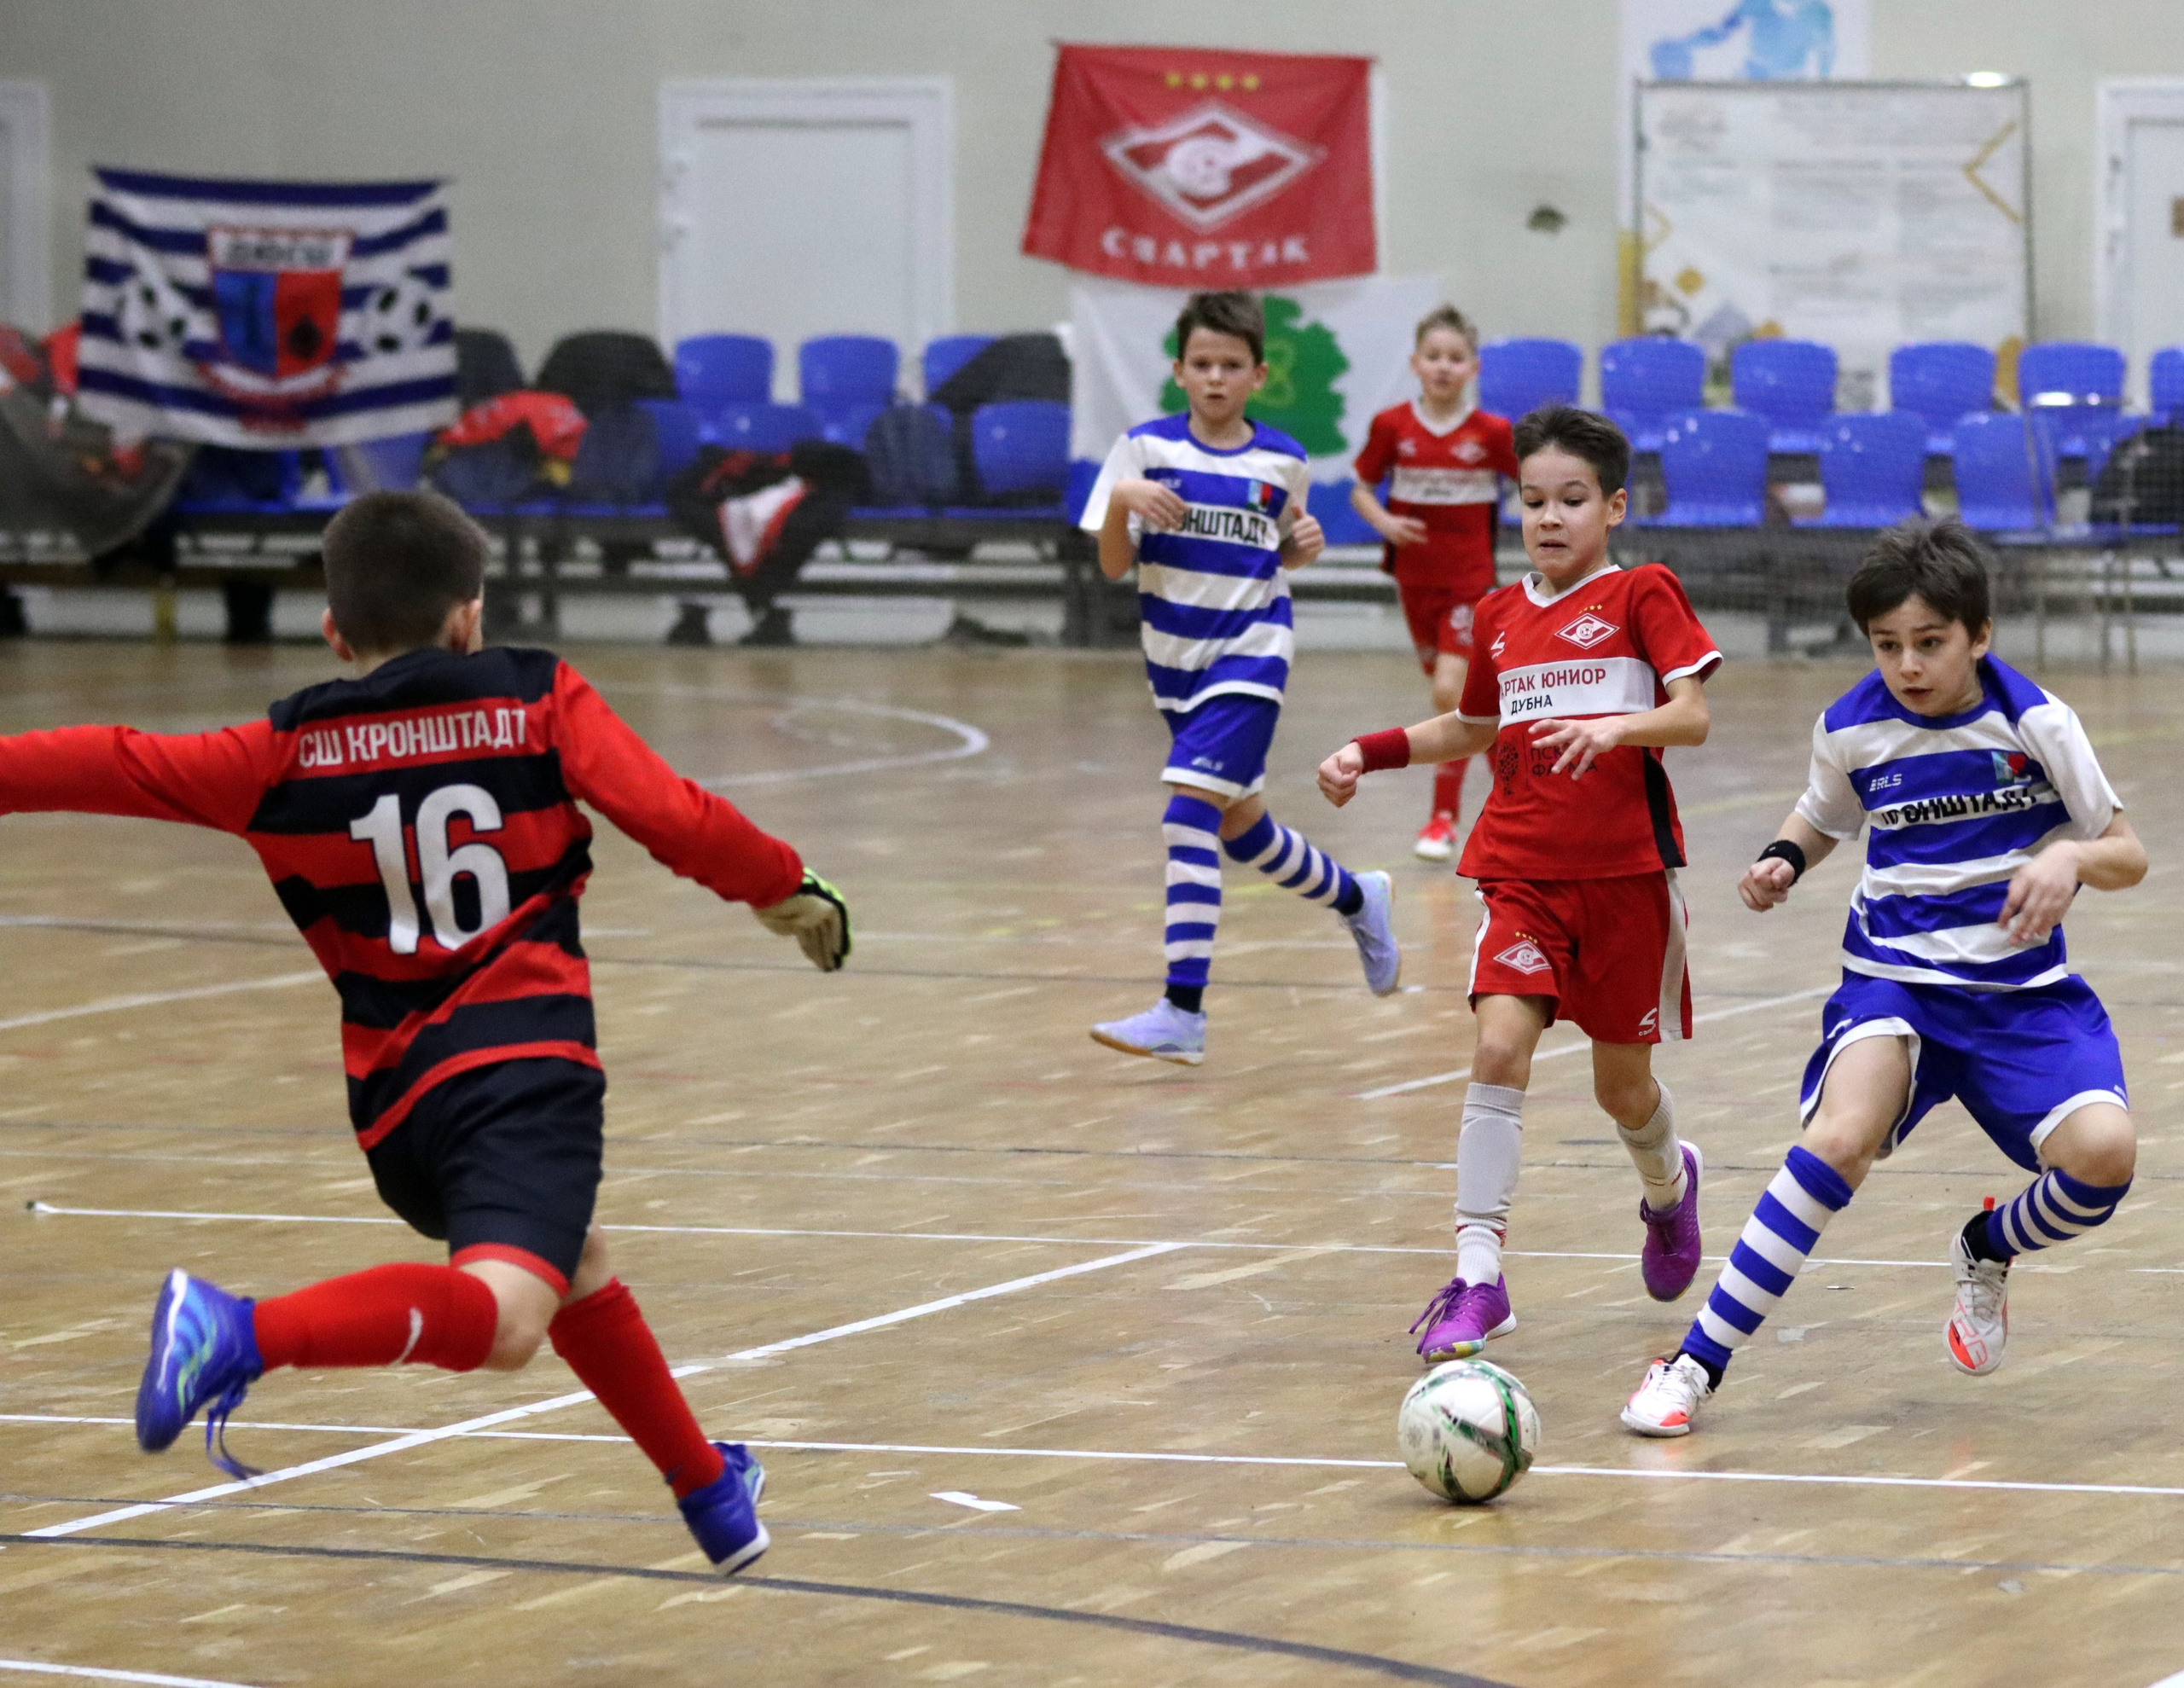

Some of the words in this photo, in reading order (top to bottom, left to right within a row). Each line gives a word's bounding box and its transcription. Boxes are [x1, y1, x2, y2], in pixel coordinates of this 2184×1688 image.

[1542, 669, 1606, 688] ЮНИОР
[1511, 695, 1553, 715] ДУБНА
[299, 728, 343, 767] СШ
[346, 709, 526, 763] КРОНШТАДТ
[350, 784, 511, 954] 16
